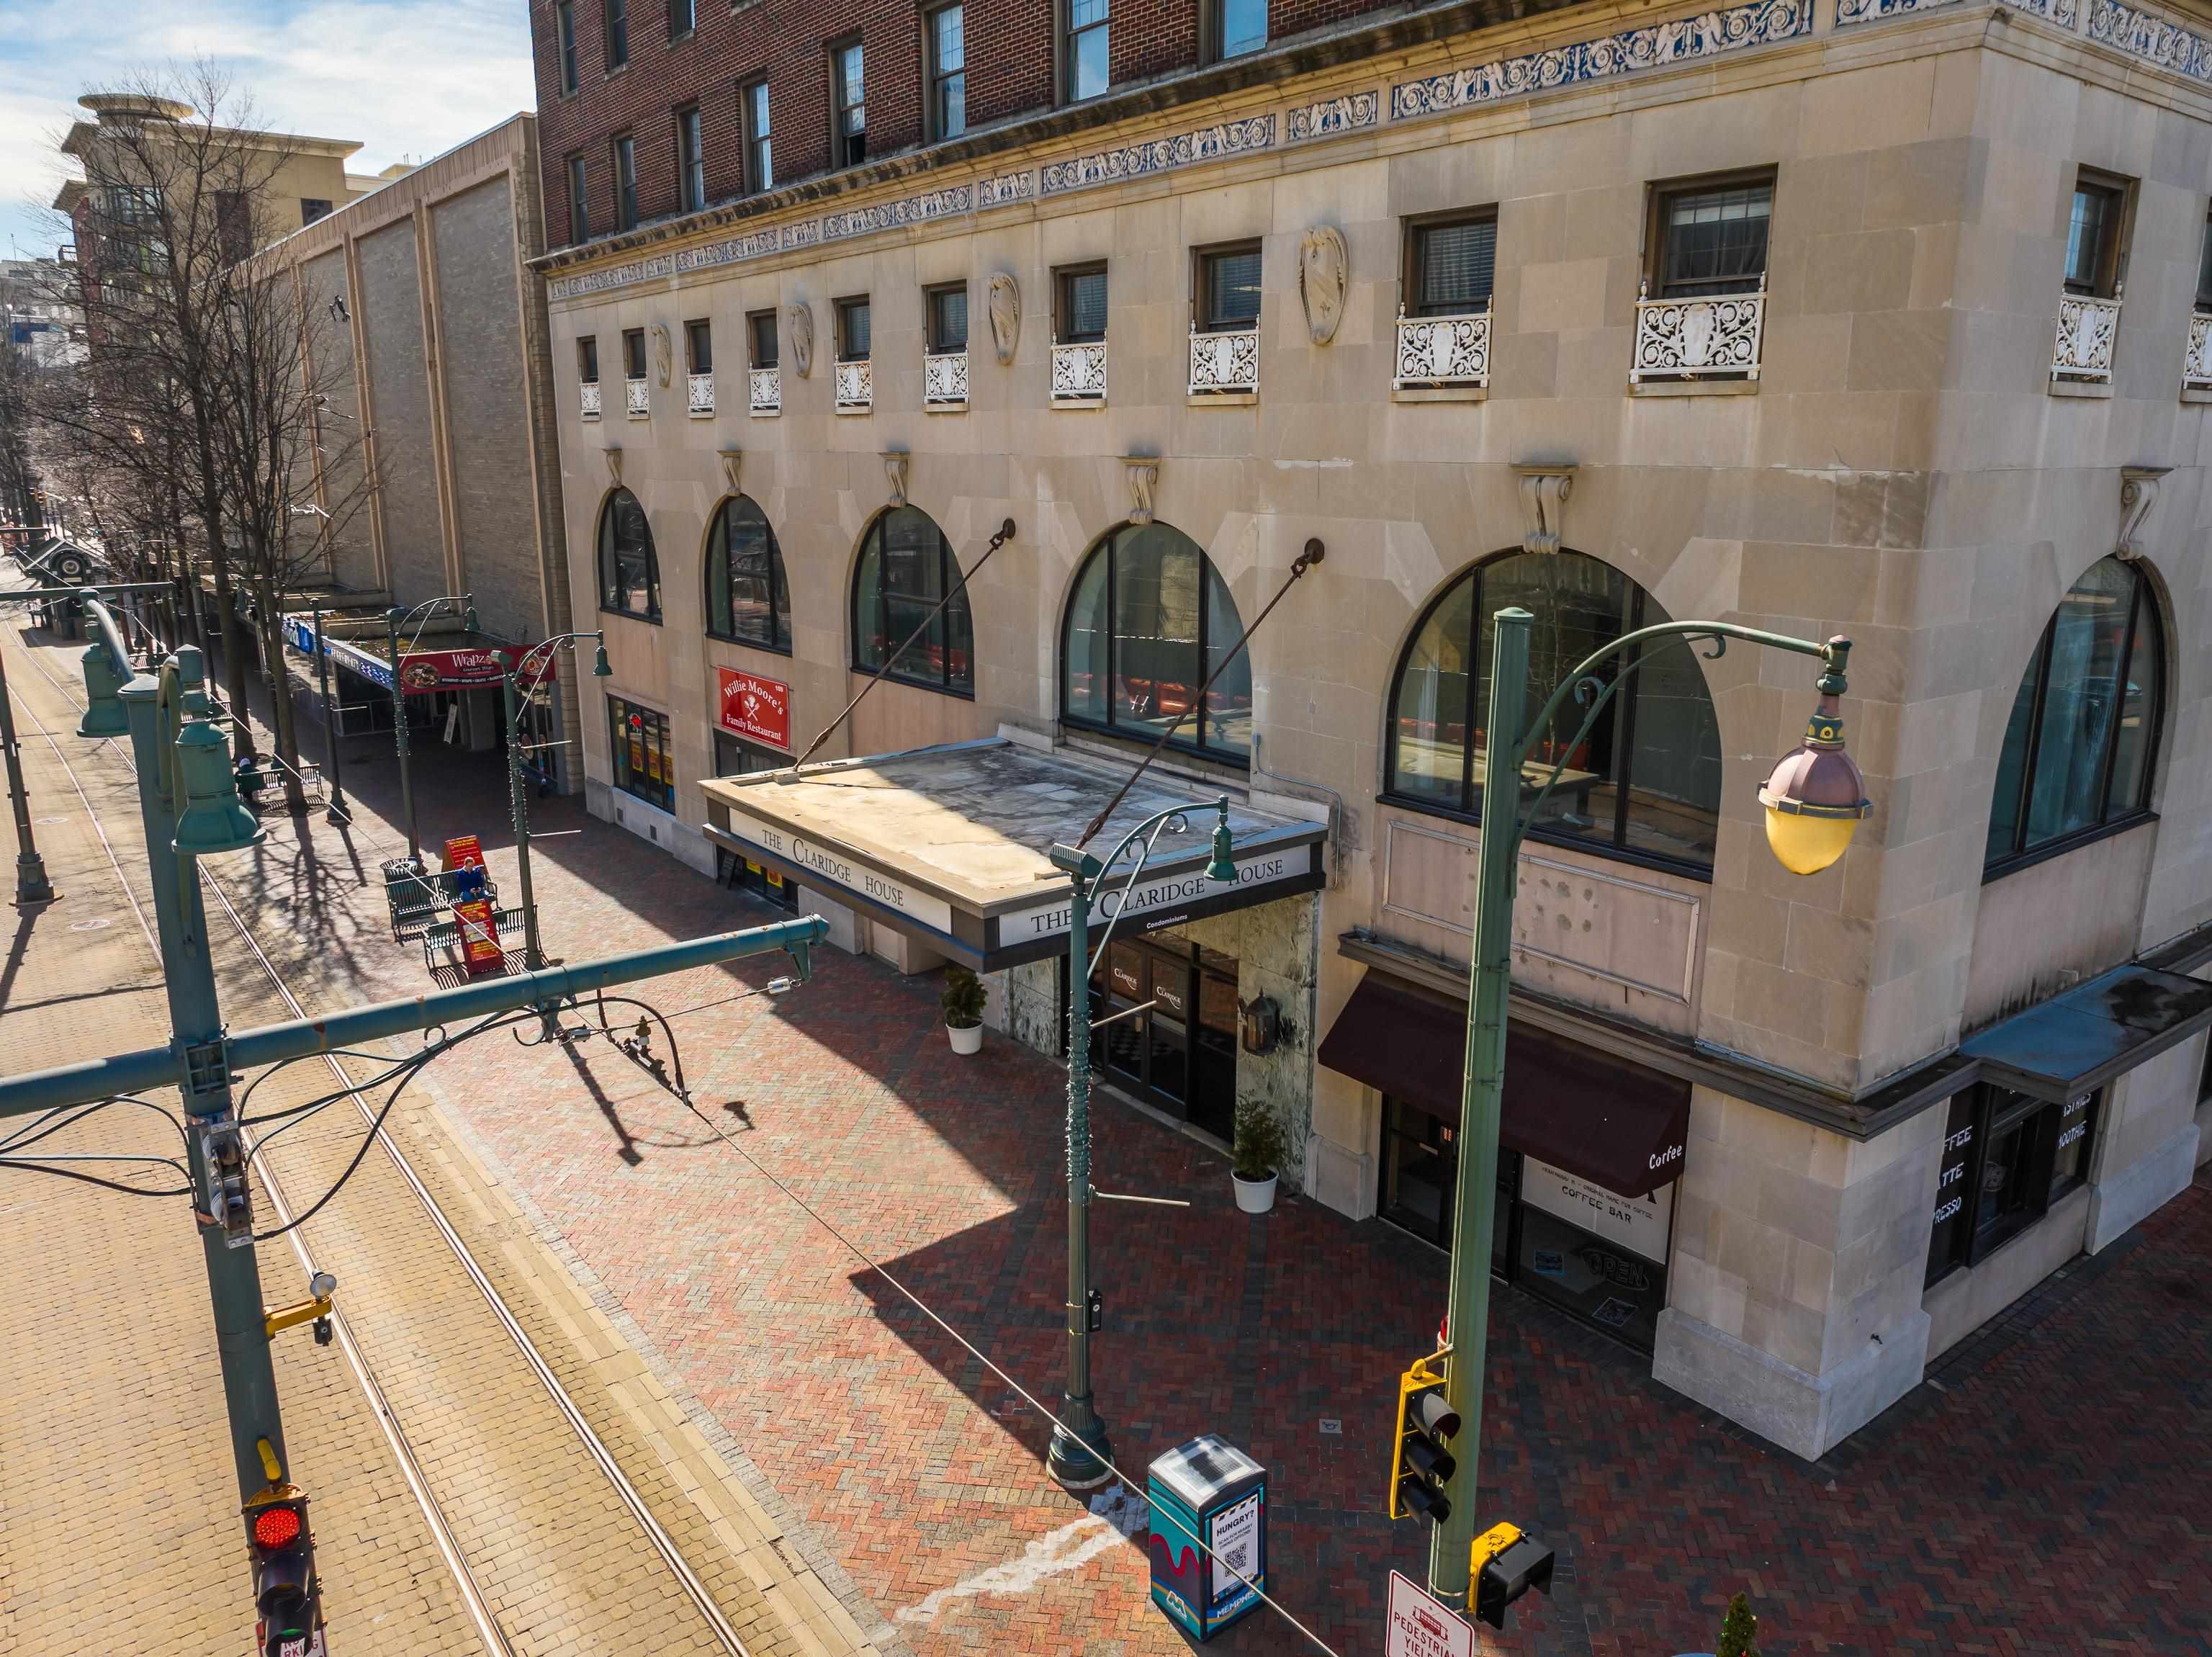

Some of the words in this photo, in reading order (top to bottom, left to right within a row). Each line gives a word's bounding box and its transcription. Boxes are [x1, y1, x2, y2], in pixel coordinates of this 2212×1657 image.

[452, 654, 485, 668] Wrapz
[724, 679, 747, 698] Willie
[747, 680, 783, 715] Moore's
[726, 713, 746, 732] Family
[747, 720, 782, 741] Restaurant
[763, 829, 782, 850] THE
[793, 838, 851, 883] CLARIDGE
[866, 875, 904, 907] HOUSE
[1030, 908, 1072, 933] THE
[1146, 915, 1188, 929] Condominiums
[1944, 1125, 1973, 1151] FFEE
[1942, 1162, 1964, 1187] TTE
[1561, 1186, 1604, 1211] COFFEE
[1609, 1205, 1632, 1224] BAR
[1934, 1196, 1962, 1224] RESSO
[1589, 1253, 1644, 1286] OPEN
[1216, 1509, 1255, 1537] HUNGRY?
[1217, 1589, 1256, 1618] MEMPHIS
[1394, 1612, 1457, 1657] PEDESTRIA
